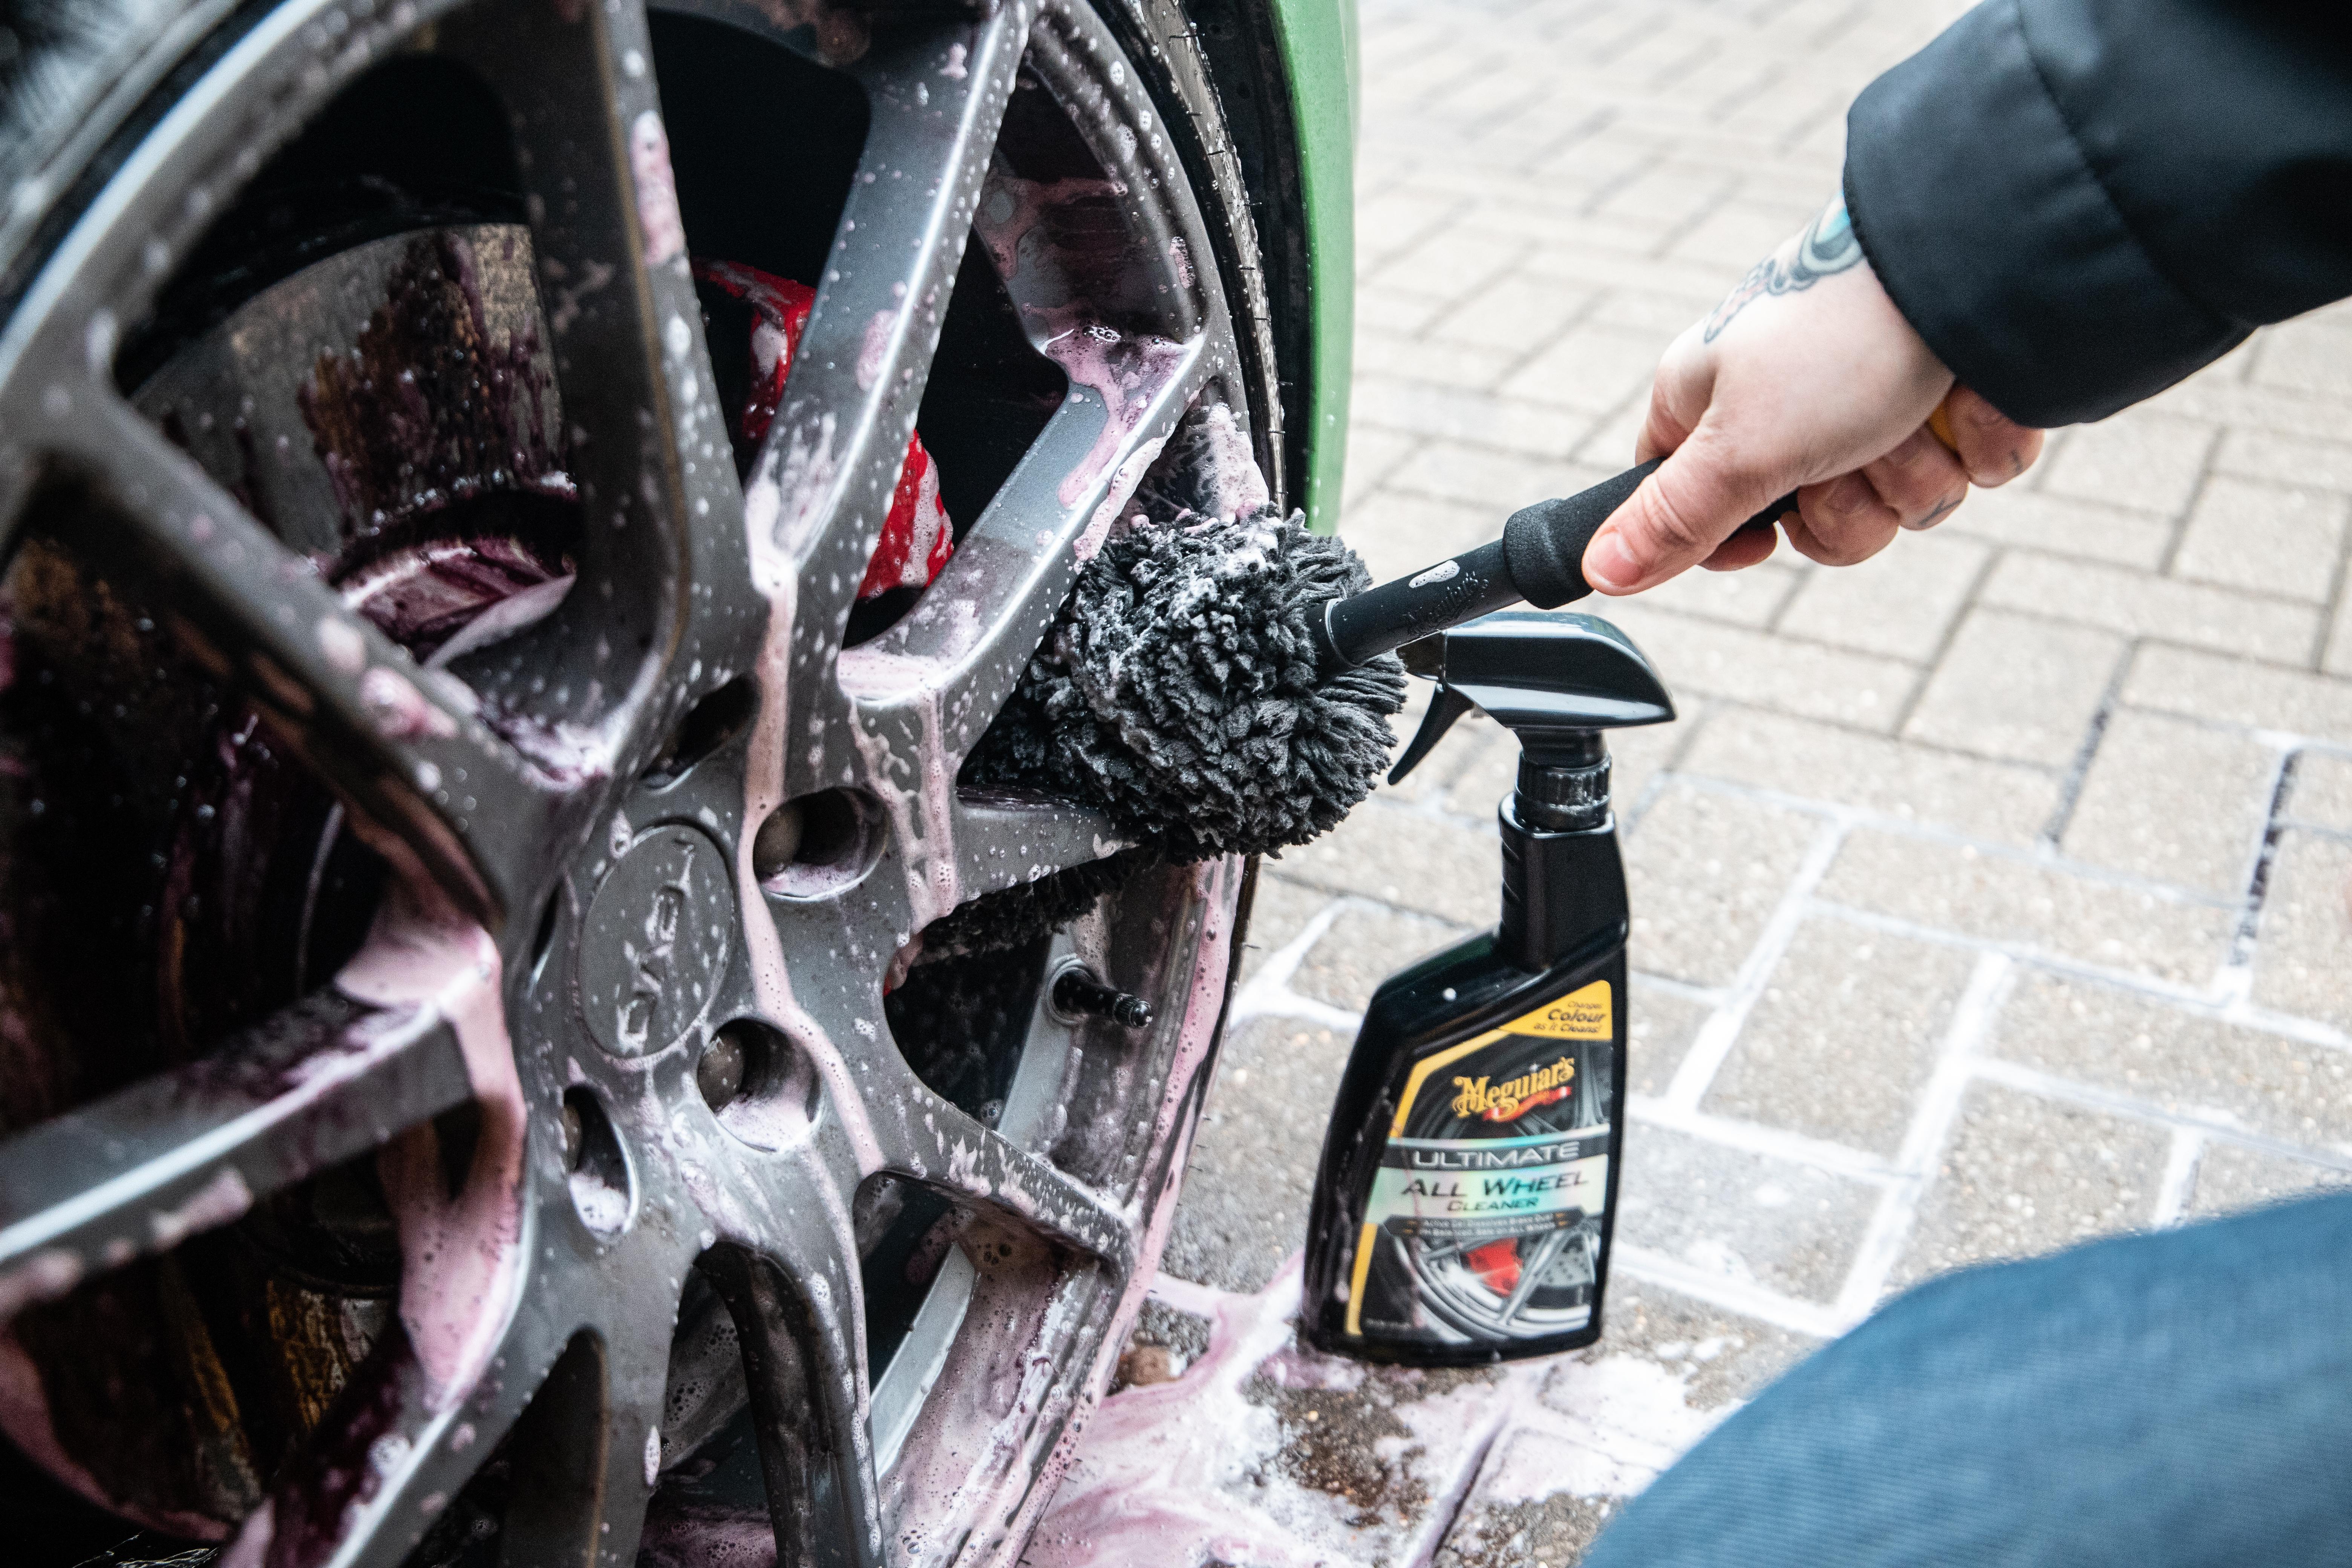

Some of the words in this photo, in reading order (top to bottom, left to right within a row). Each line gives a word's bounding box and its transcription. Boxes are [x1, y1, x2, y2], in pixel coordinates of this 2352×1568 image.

[1548, 1008, 1607, 1022] Colour
[1451, 1057, 1574, 1122] Meguiar's
[1413, 1141, 1580, 1167] ULTIMATE
[1401, 1178, 1467, 1196] ALL
[1484, 1171, 1588, 1196] WHEEL
[1447, 1197, 1539, 1211] CLEANER
